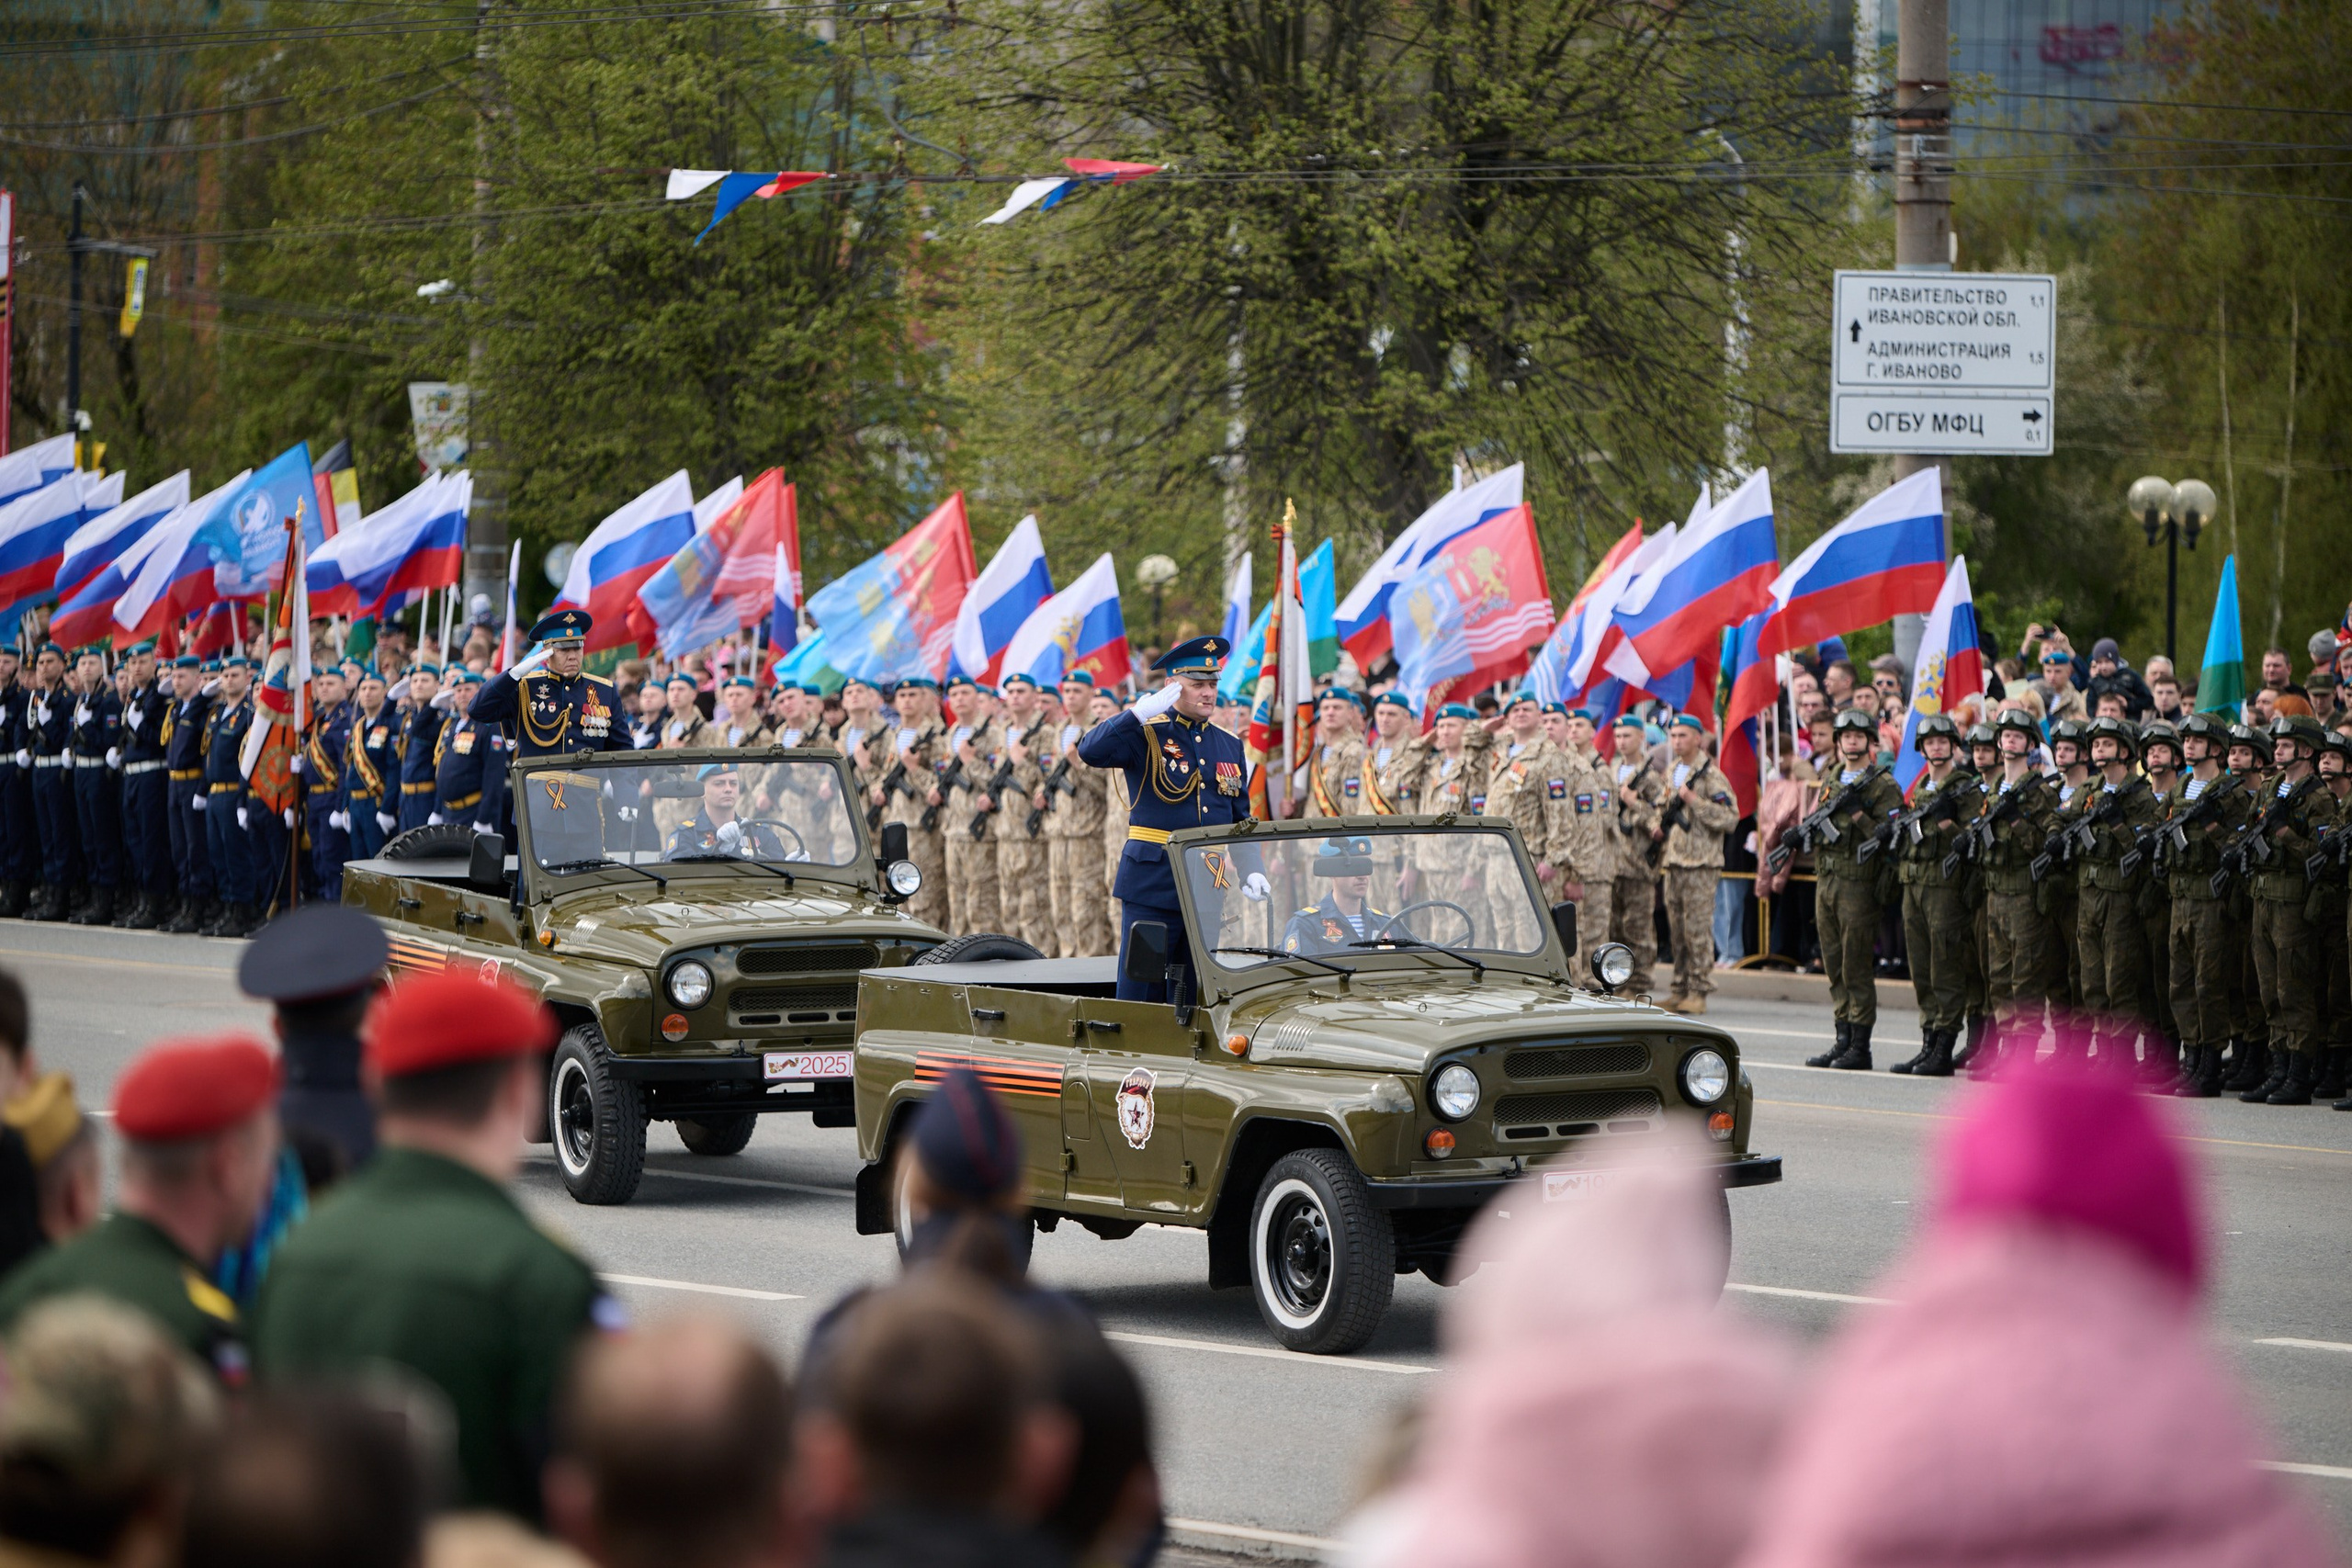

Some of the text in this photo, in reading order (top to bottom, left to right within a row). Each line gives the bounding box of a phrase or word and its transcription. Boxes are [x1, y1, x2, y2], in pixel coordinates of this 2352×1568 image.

[1869, 286, 2007, 305] ПРАВИТЕЛЬСТВО
[2030, 294, 2044, 309] 1,1
[1868, 307, 2021, 328] ИВАНОВСКОЙ ОБЛ.
[1867, 342, 2011, 360] АДМИНИСТРАЦИЯ
[2029, 352, 2044, 367] 1,5
[1867, 363, 1962, 379] Г. ИВАНОВО
[1867, 412, 1984, 436] ОГБУ МФЦ
[799, 1055, 847, 1075] 2025
